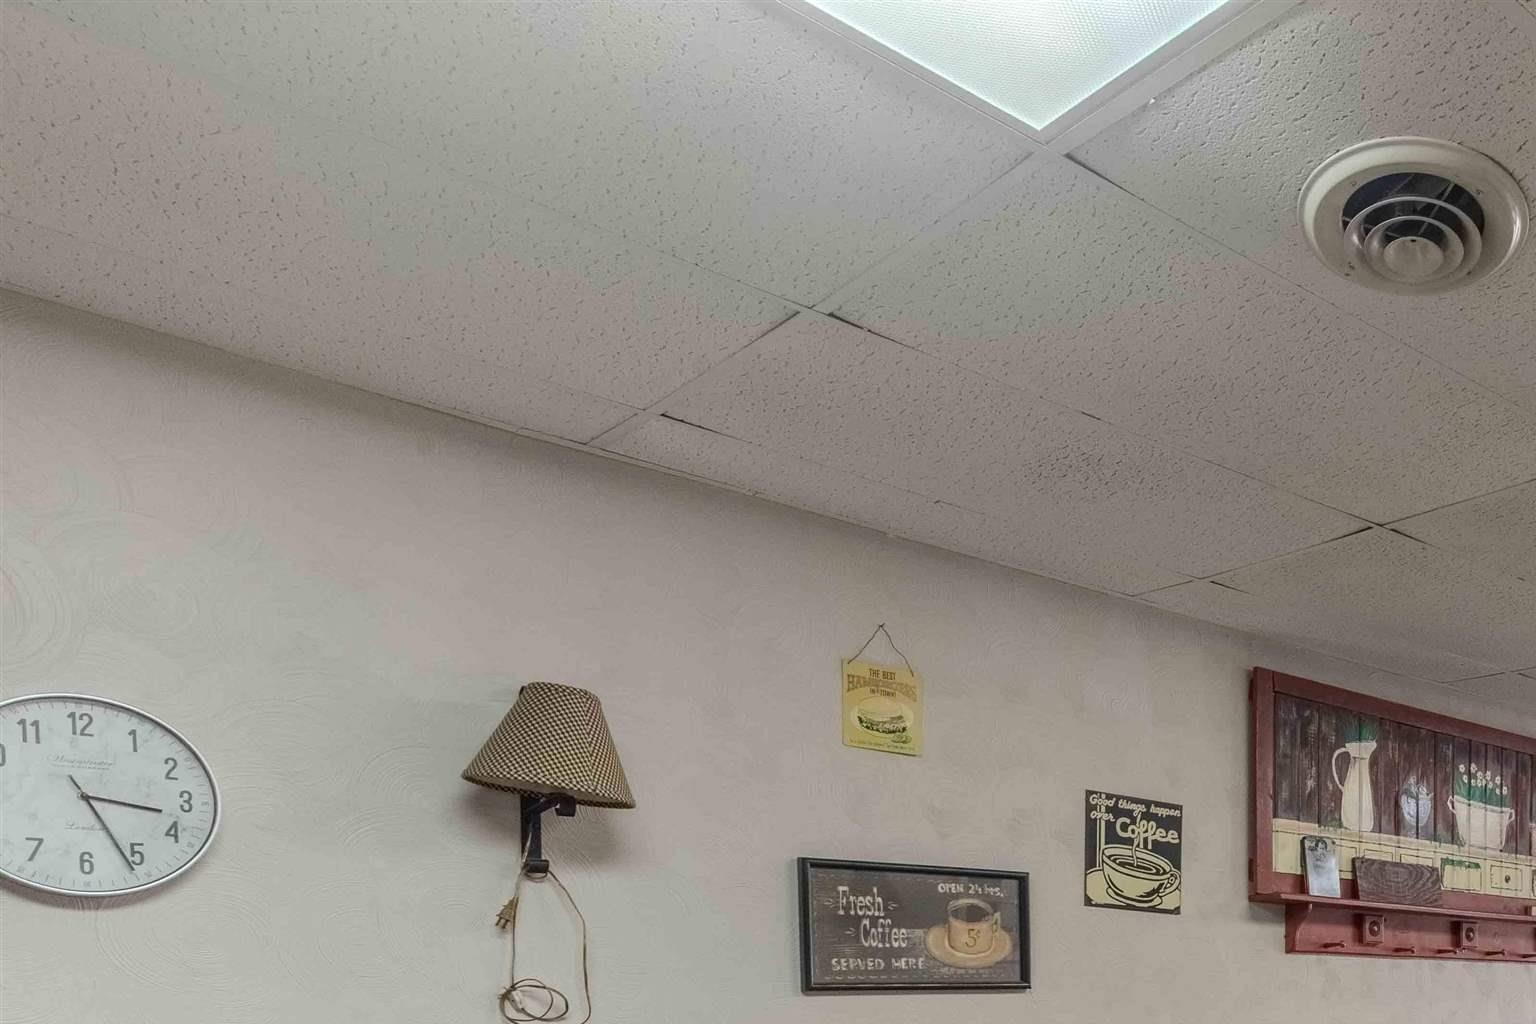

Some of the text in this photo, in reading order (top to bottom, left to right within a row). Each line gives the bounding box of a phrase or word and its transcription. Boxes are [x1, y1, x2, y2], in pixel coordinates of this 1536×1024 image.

[16, 718, 41, 744] 11
[67, 711, 94, 737] 12
[128, 729, 138, 752] 1
[164, 757, 179, 780] 2
[179, 790, 193, 813] 3
[1089, 793, 1181, 818] Good things happen
[164, 820, 180, 844] 4
[1090, 810, 1180, 850] over Coffee
[25, 837, 44, 862] 7
[129, 842, 145, 866] 5
[79, 851, 94, 875] 6
[937, 883, 964, 894] OPEN
[837, 886, 885, 917] Fresh
[860, 917, 908, 948] Coffee
[831, 956, 925, 971] SERVED HERE
